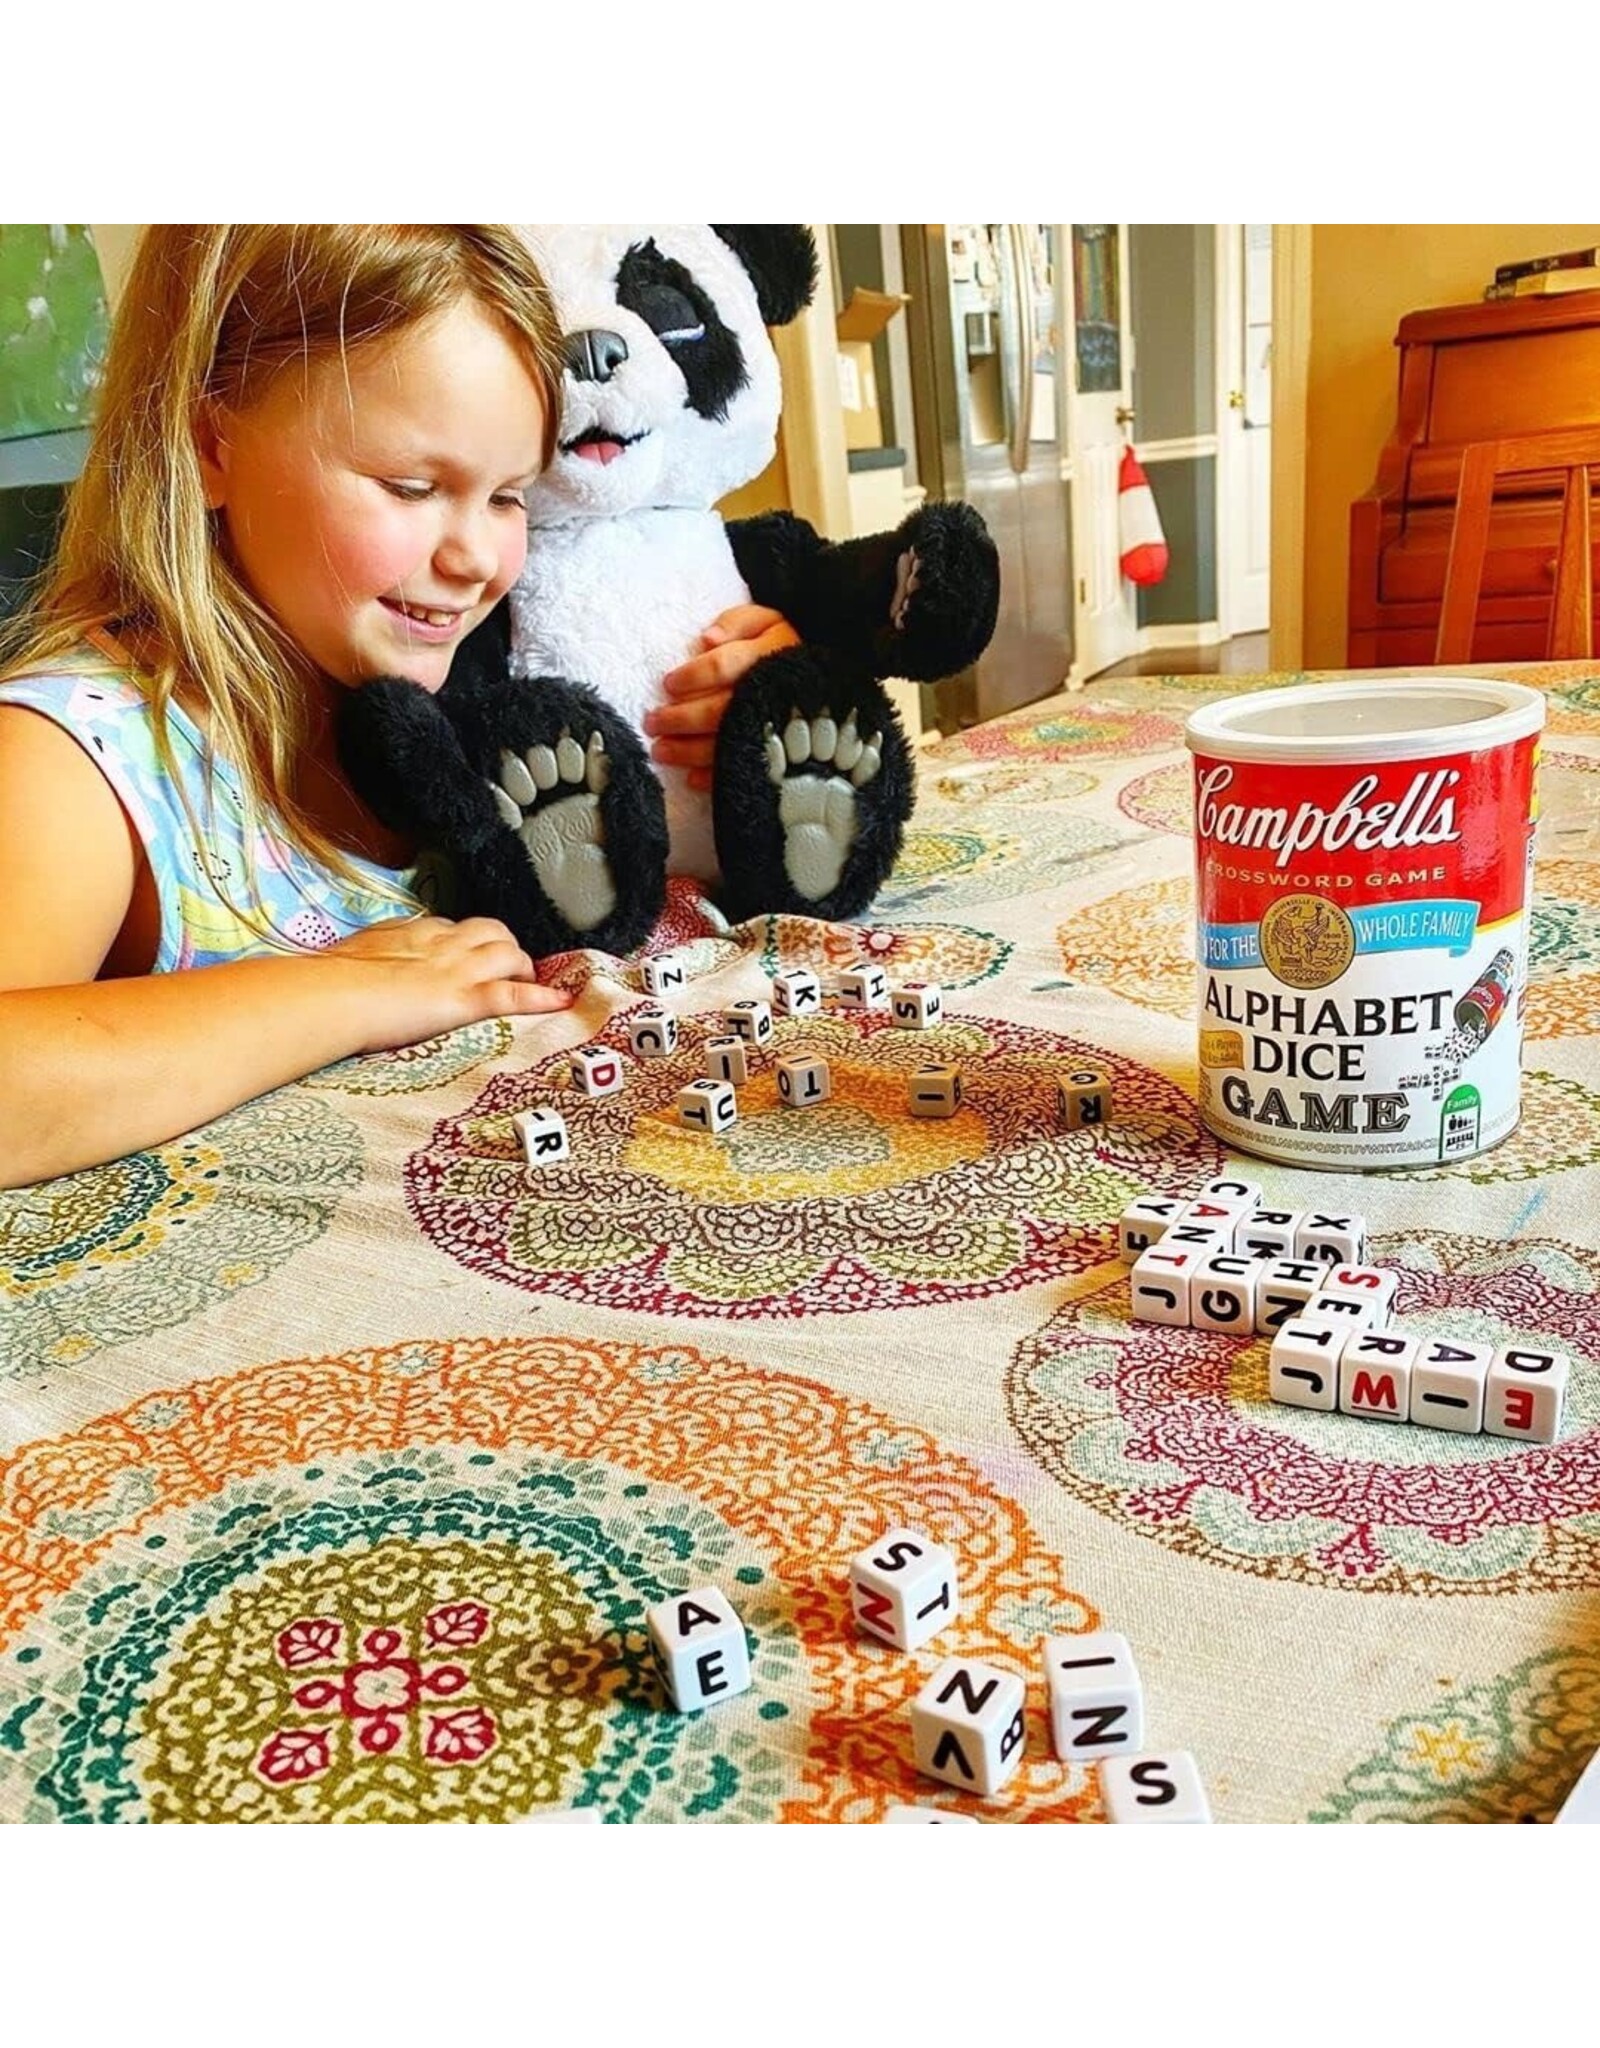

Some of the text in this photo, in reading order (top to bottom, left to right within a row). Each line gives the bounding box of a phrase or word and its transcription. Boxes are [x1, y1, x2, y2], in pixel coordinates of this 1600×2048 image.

[1198, 765, 1463, 869] Campbell's
[1364, 866, 1447, 888] GAME
[1357, 914, 1418, 944] WHOLE
[1419, 911, 1474, 939] FAMILY
[1209, 937, 1230, 961] FOR
[1230, 934, 1258, 960] THE
[794, 985, 817, 1007] K
[841, 985, 863, 1001] T
[896, 1001, 918, 1020] S
[1203, 975, 1453, 1037] ALPHABET
[1252, 1035, 1367, 1082] DICE
[592, 1062, 616, 1087] D
[1221, 1076, 1412, 1135] GAME
[534, 1131, 563, 1156] R
[1210, 1182, 1249, 1196] C
[1189, 1204, 1230, 1218] A
[1250, 1211, 1293, 1225] R
[1308, 1214, 1352, 1231] X
[1337, 1270, 1381, 1289] S
[1317, 1298, 1363, 1316] E
[1358, 1335, 1407, 1355] R
[1427, 1343, 1477, 1363] A
[1504, 1350, 1554, 1374] D
[872, 1541, 923, 1572] S
[916, 1581, 950, 1620] T
[677, 1601, 722, 1637] A
[696, 1649, 729, 1697] E
[1000, 1708, 1025, 1764] B
[1129, 1760, 1178, 1806] S
